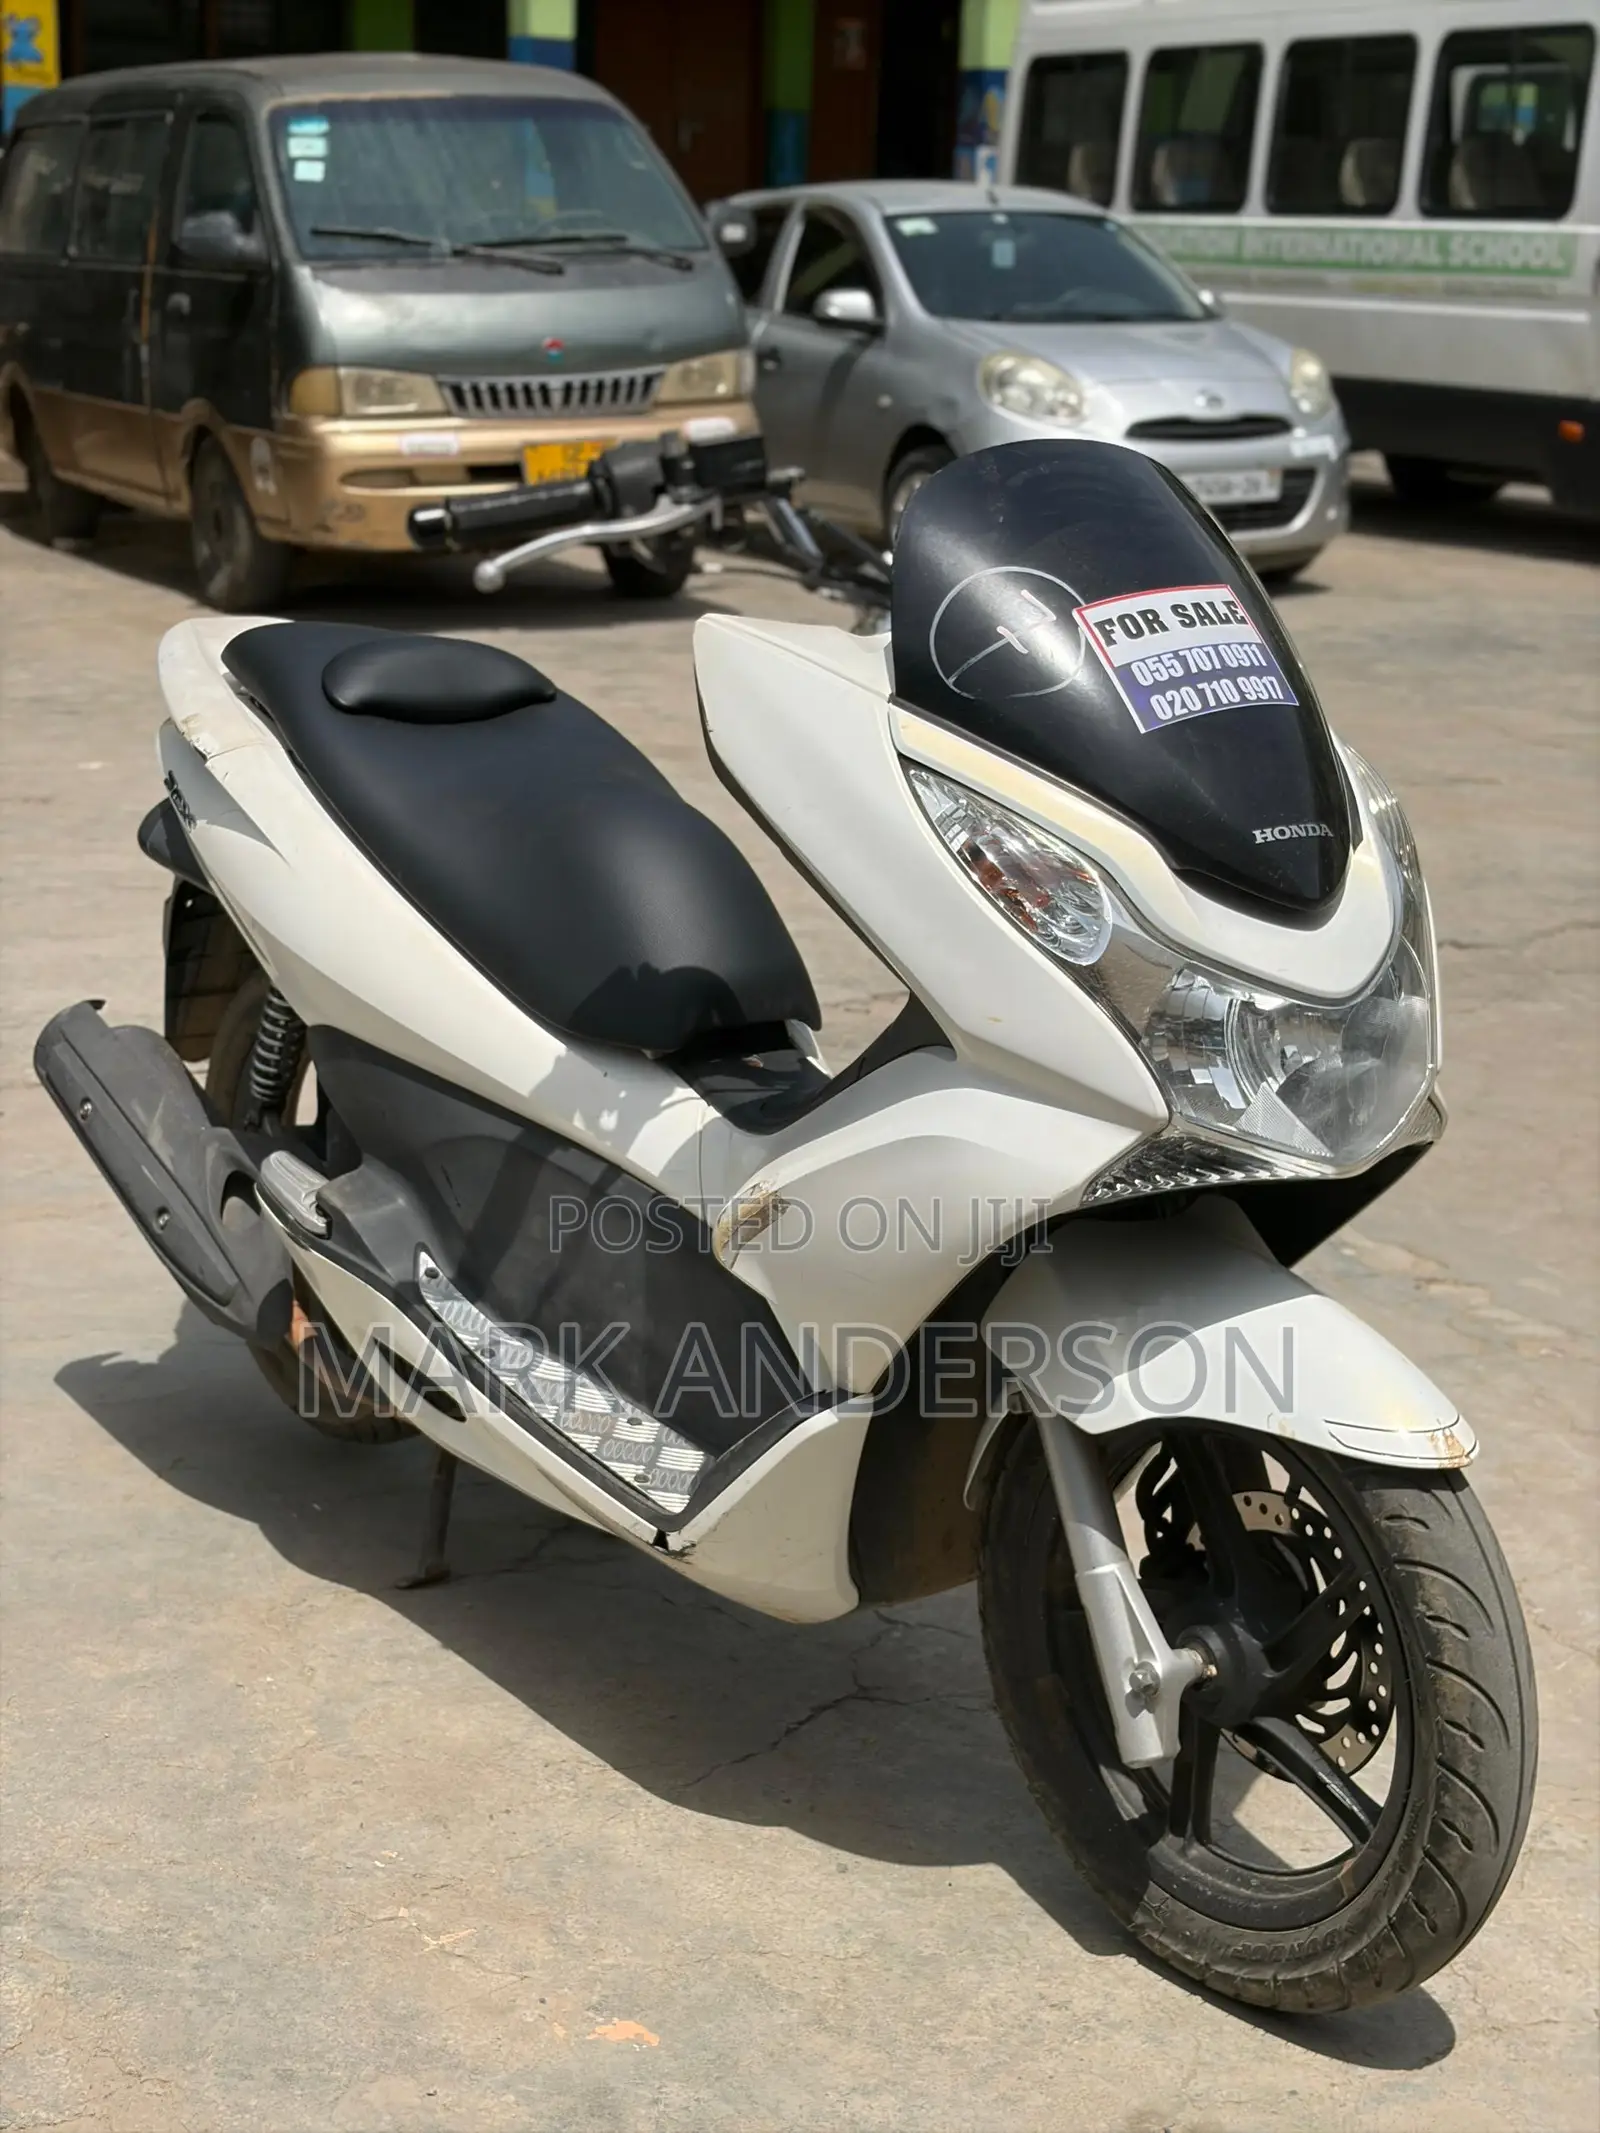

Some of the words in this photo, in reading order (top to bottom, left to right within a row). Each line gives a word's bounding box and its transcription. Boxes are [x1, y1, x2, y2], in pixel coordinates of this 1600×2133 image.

[1448, 231, 1565, 269] SCHOOL
[1093, 609, 1170, 647] FOR
[1169, 600, 1249, 630] SALE
[1130, 650, 1183, 687] 055
[1182, 645, 1221, 673] 707
[1216, 643, 1267, 670] 0911
[1149, 687, 1203, 721] 020
[1199, 678, 1241, 707] 710
[1234, 674, 1285, 702] 9917
[1252, 823, 1334, 844] HONDA
